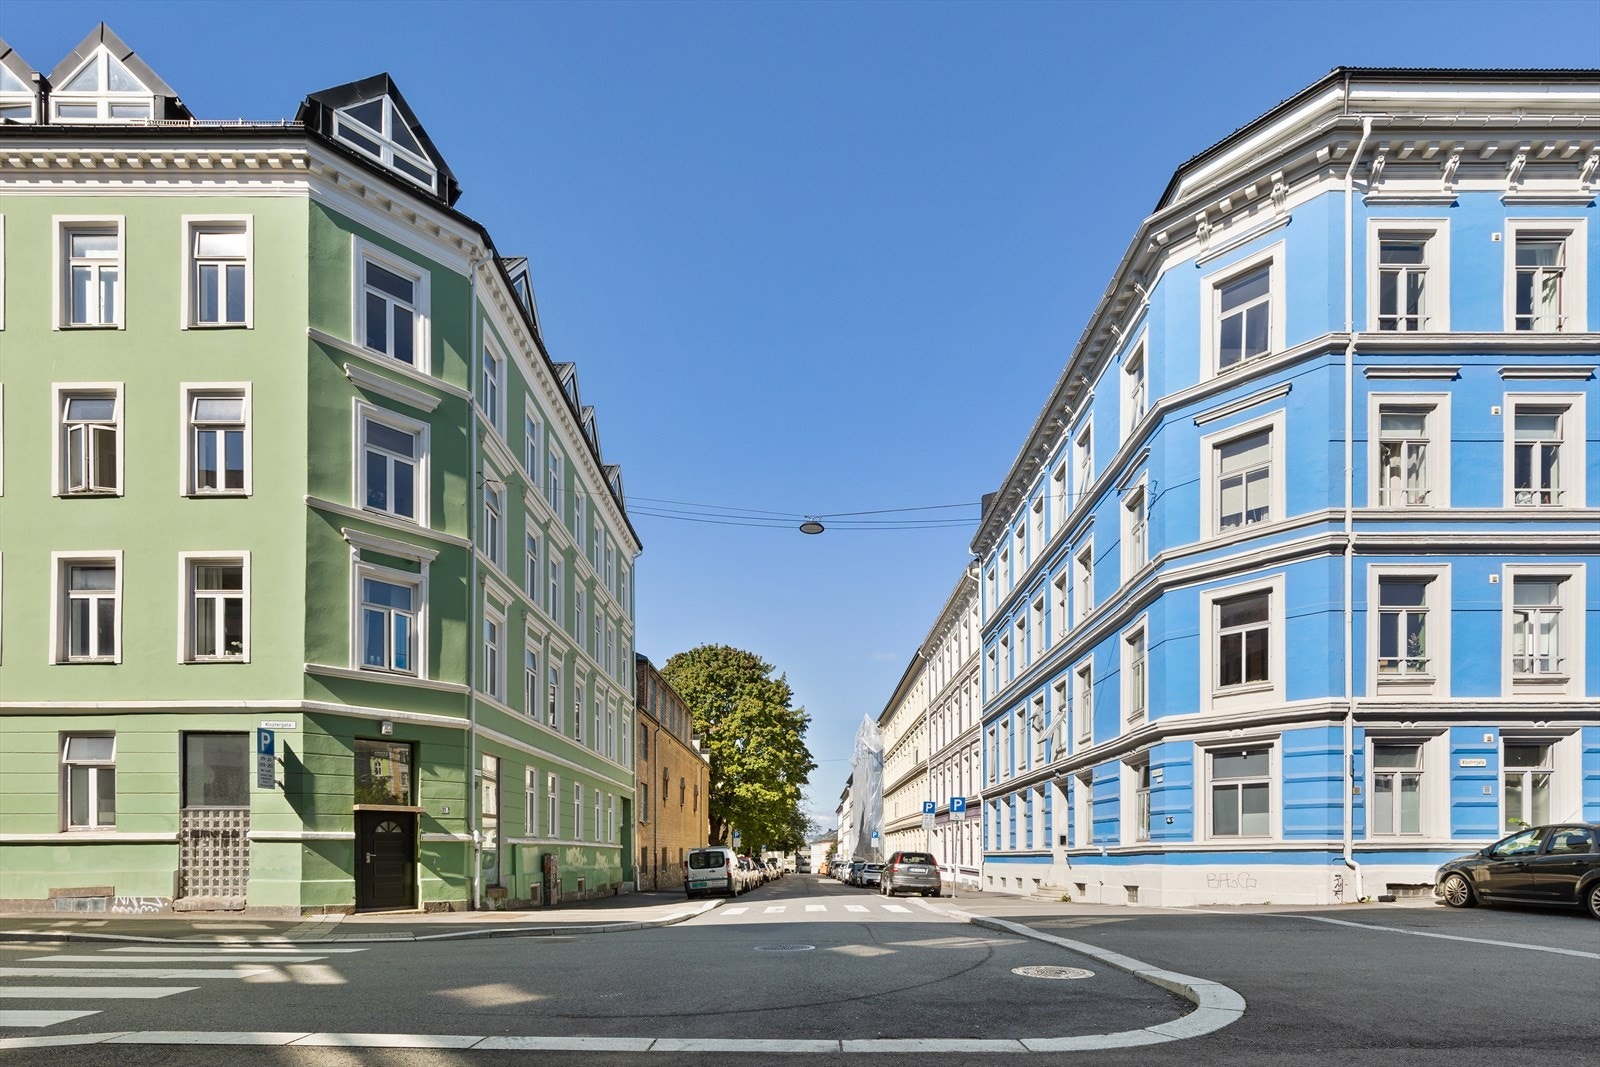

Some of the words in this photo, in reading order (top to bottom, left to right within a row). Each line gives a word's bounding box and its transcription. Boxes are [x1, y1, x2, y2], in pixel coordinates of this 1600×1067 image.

[261, 732, 271, 751] P
[925, 802, 933, 812] P
[954, 799, 963, 811] P
